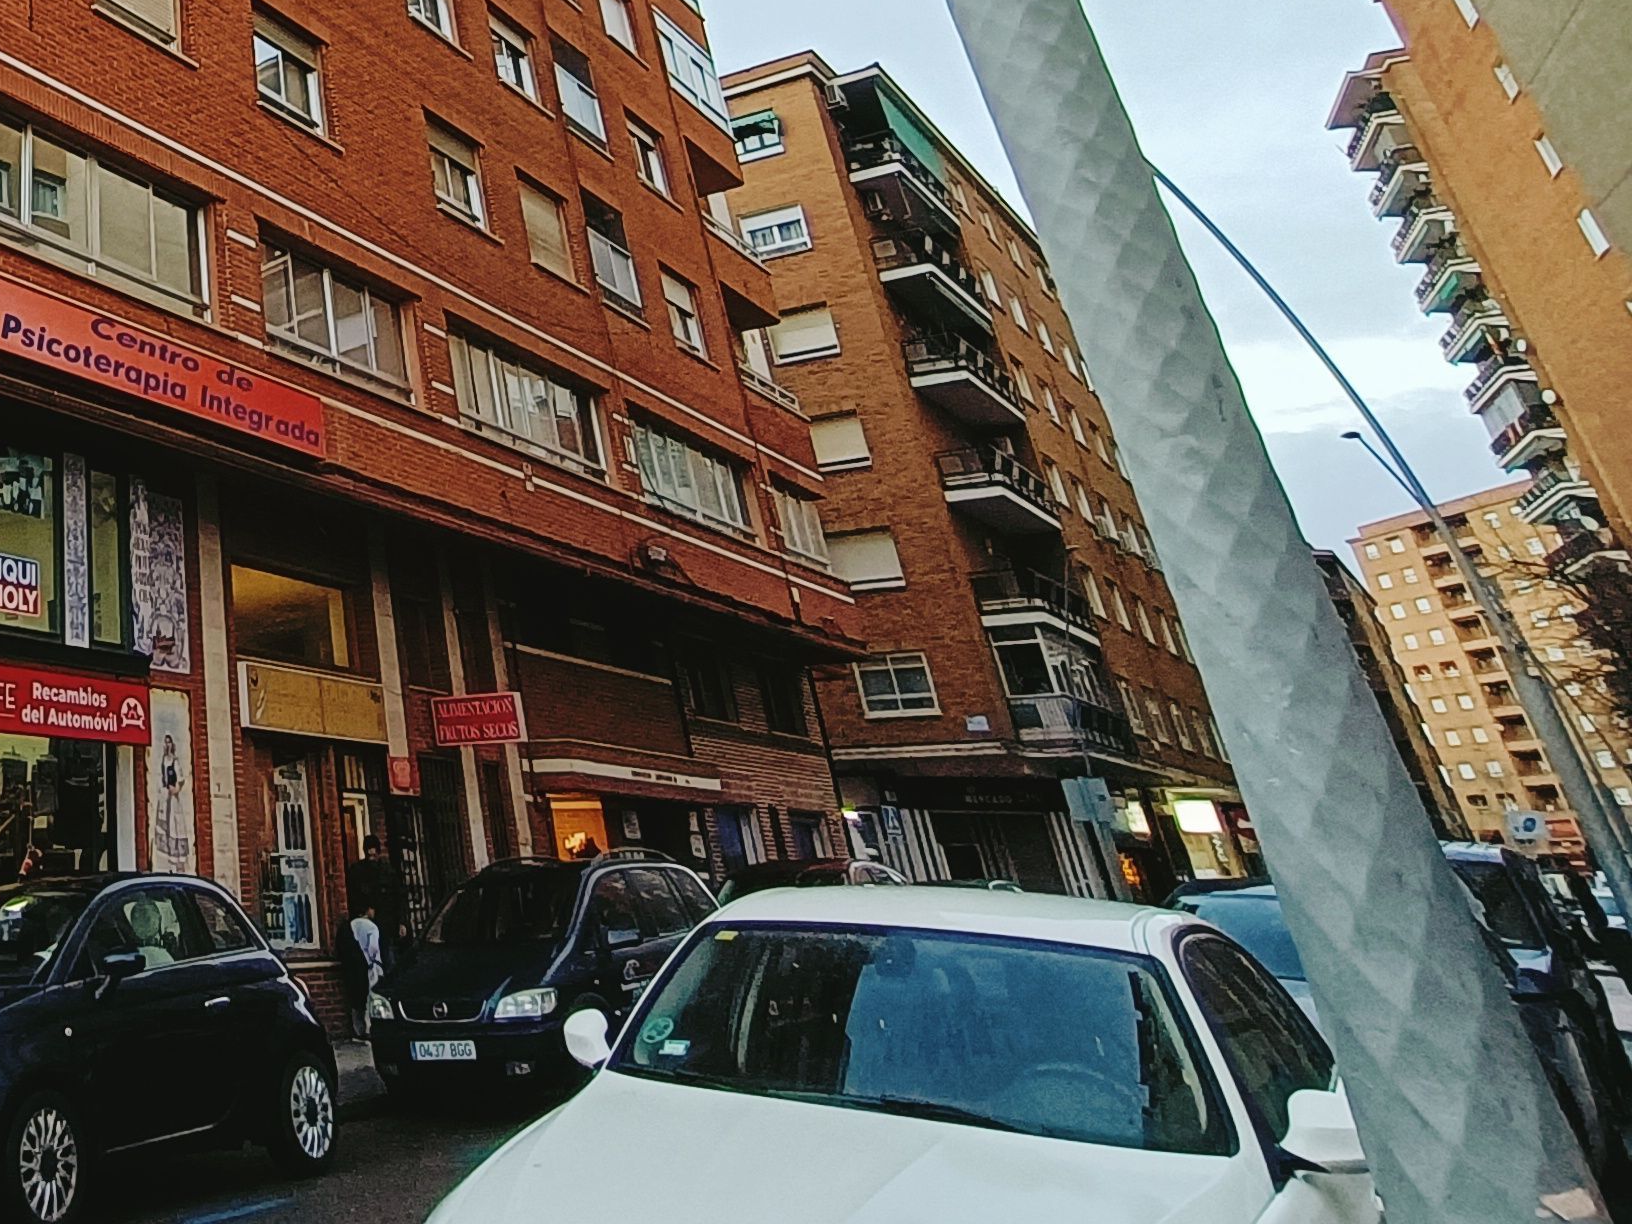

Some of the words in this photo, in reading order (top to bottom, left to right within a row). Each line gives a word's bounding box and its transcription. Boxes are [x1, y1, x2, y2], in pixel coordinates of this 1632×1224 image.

[90, 317, 200, 373] Centro
[216, 364, 254, 393] de
[1, 313, 187, 401] Psicoterapia
[200, 385, 320, 448] Integrada
[32, 681, 107, 708] Recambios
[21, 703, 44, 725] del
[47, 707, 118, 733] Automóvil
[439, 724, 481, 741] FRUTOS
[482, 720, 519, 739] SECOS
[419, 1042, 446, 1058] 0437
